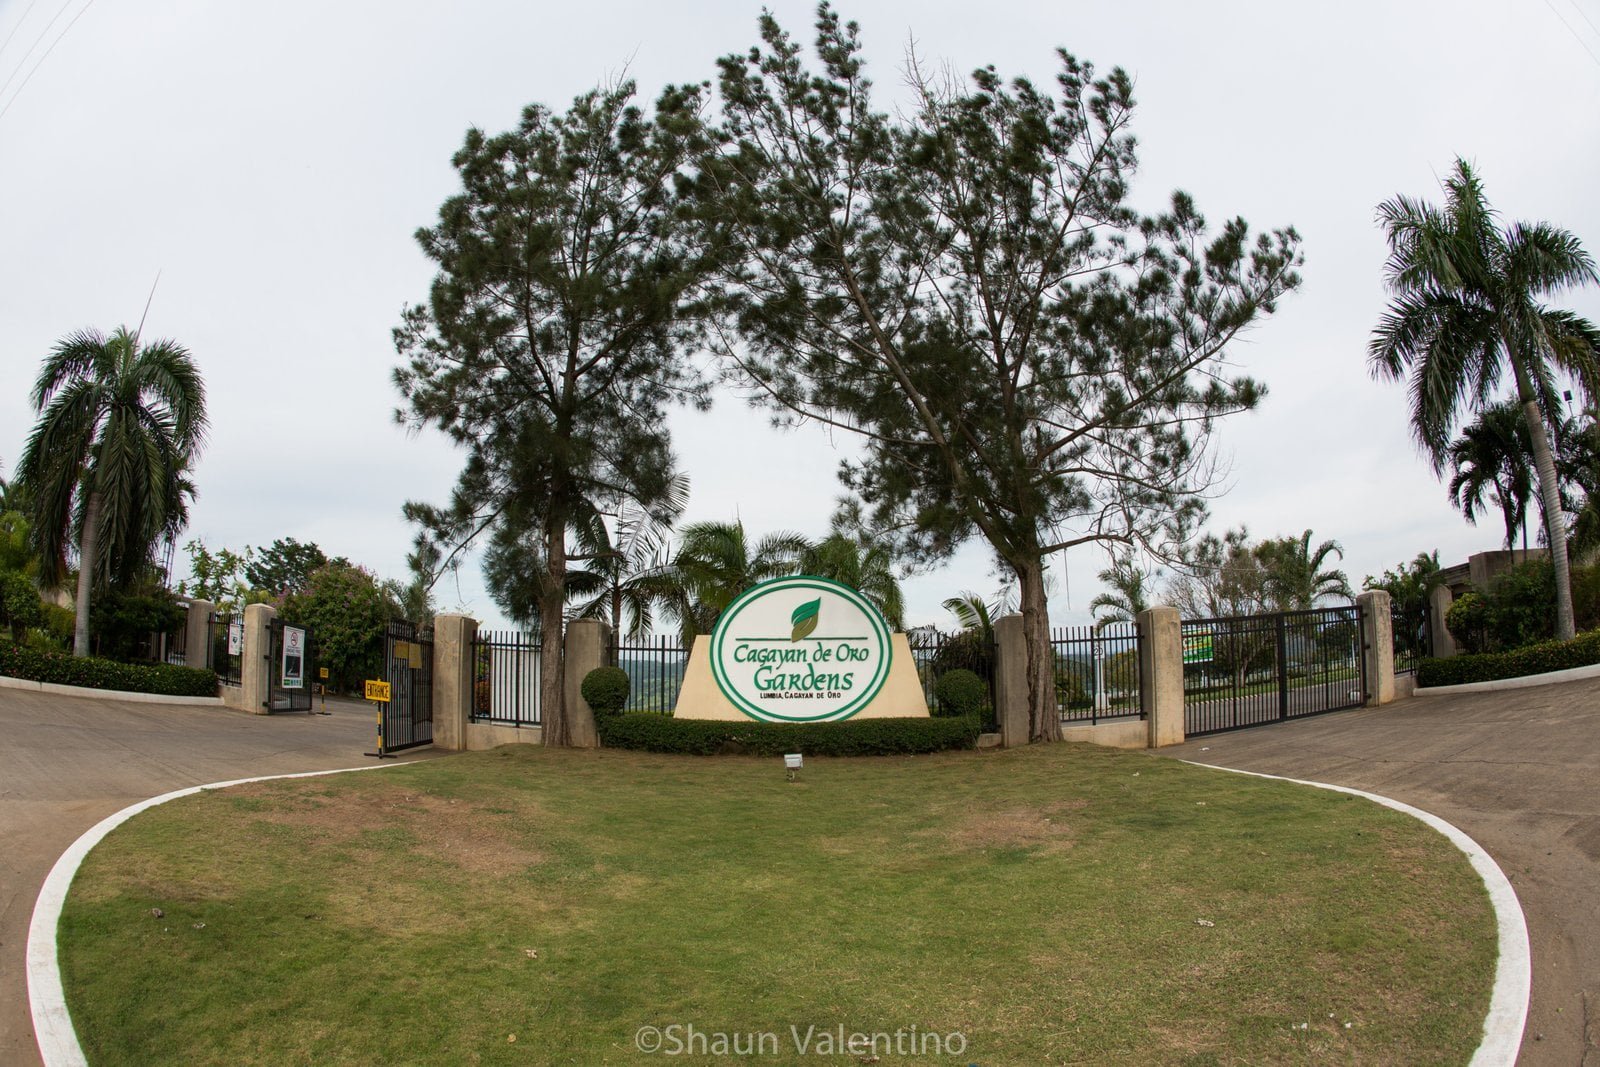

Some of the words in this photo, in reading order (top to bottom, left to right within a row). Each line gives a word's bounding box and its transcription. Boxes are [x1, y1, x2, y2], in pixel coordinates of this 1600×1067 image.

[733, 643, 808, 670] Cagayan
[812, 641, 832, 662] de
[367, 682, 389, 699] ENTRANCE
[753, 662, 854, 691] Gardens
